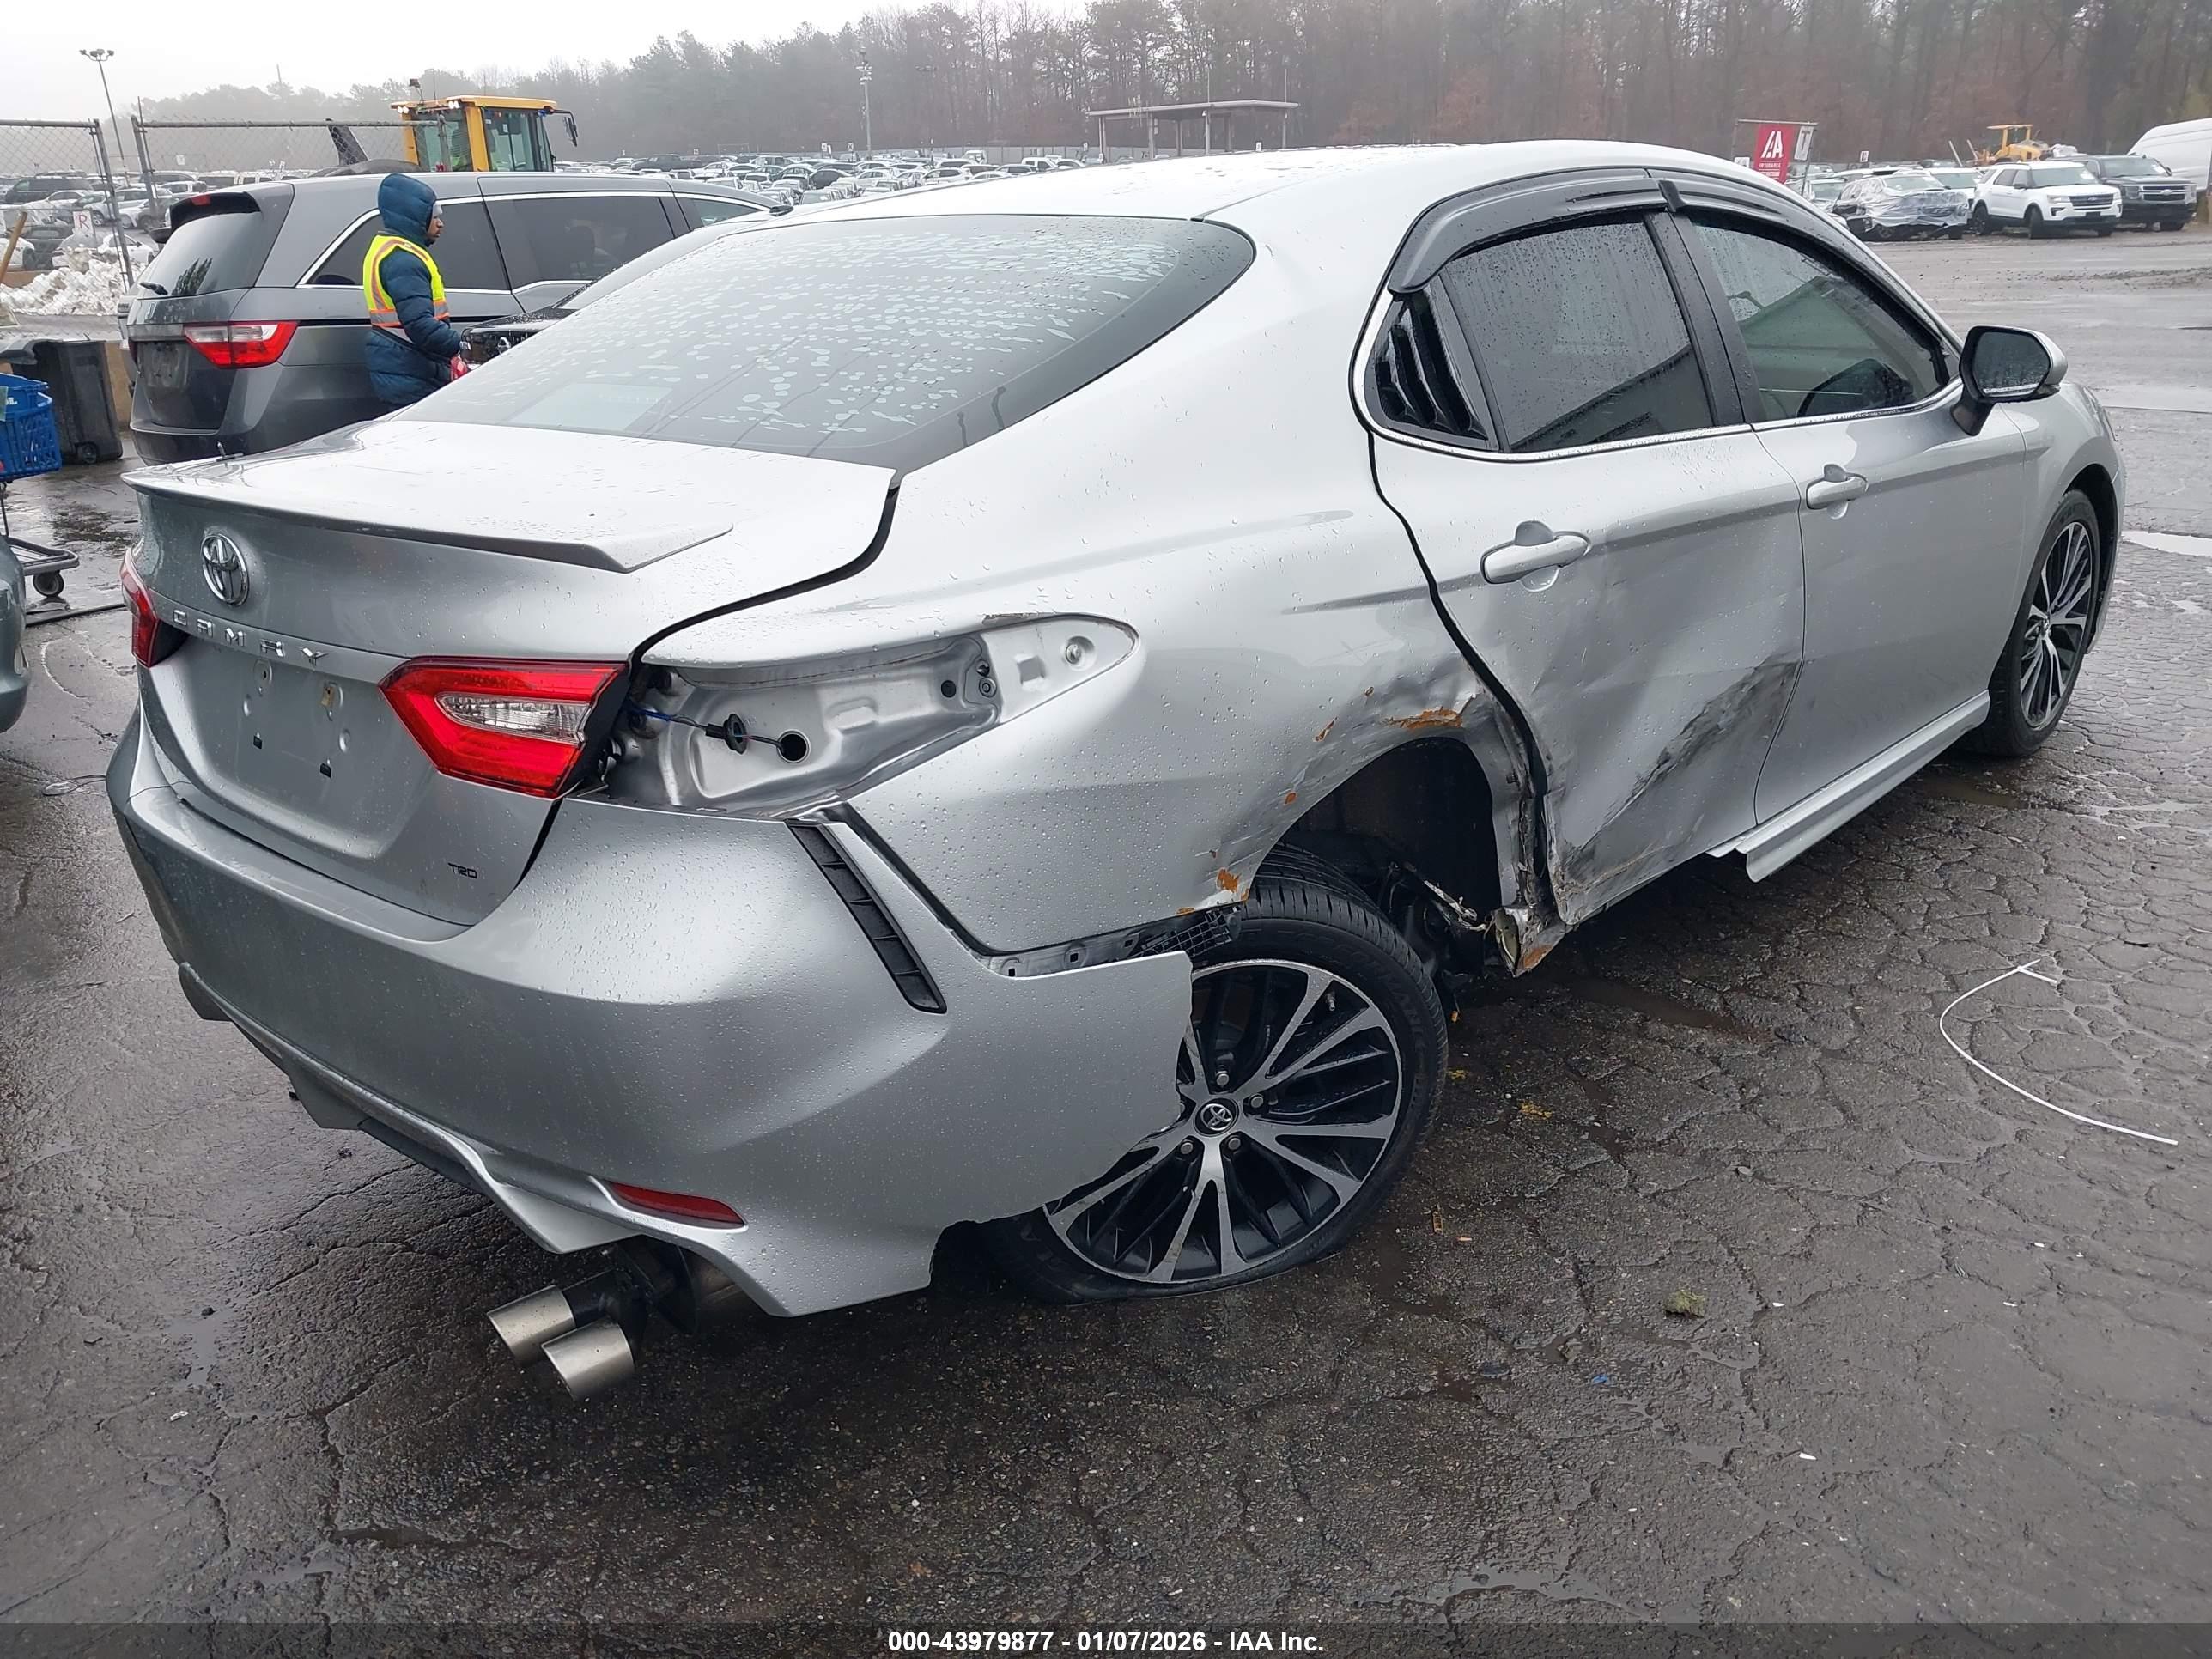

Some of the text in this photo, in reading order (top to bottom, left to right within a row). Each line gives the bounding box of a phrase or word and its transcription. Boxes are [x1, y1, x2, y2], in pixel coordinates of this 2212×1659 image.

[78, 214, 90, 229] R
[173, 609, 330, 666] CAMRY
[447, 862, 477, 879] TRD
